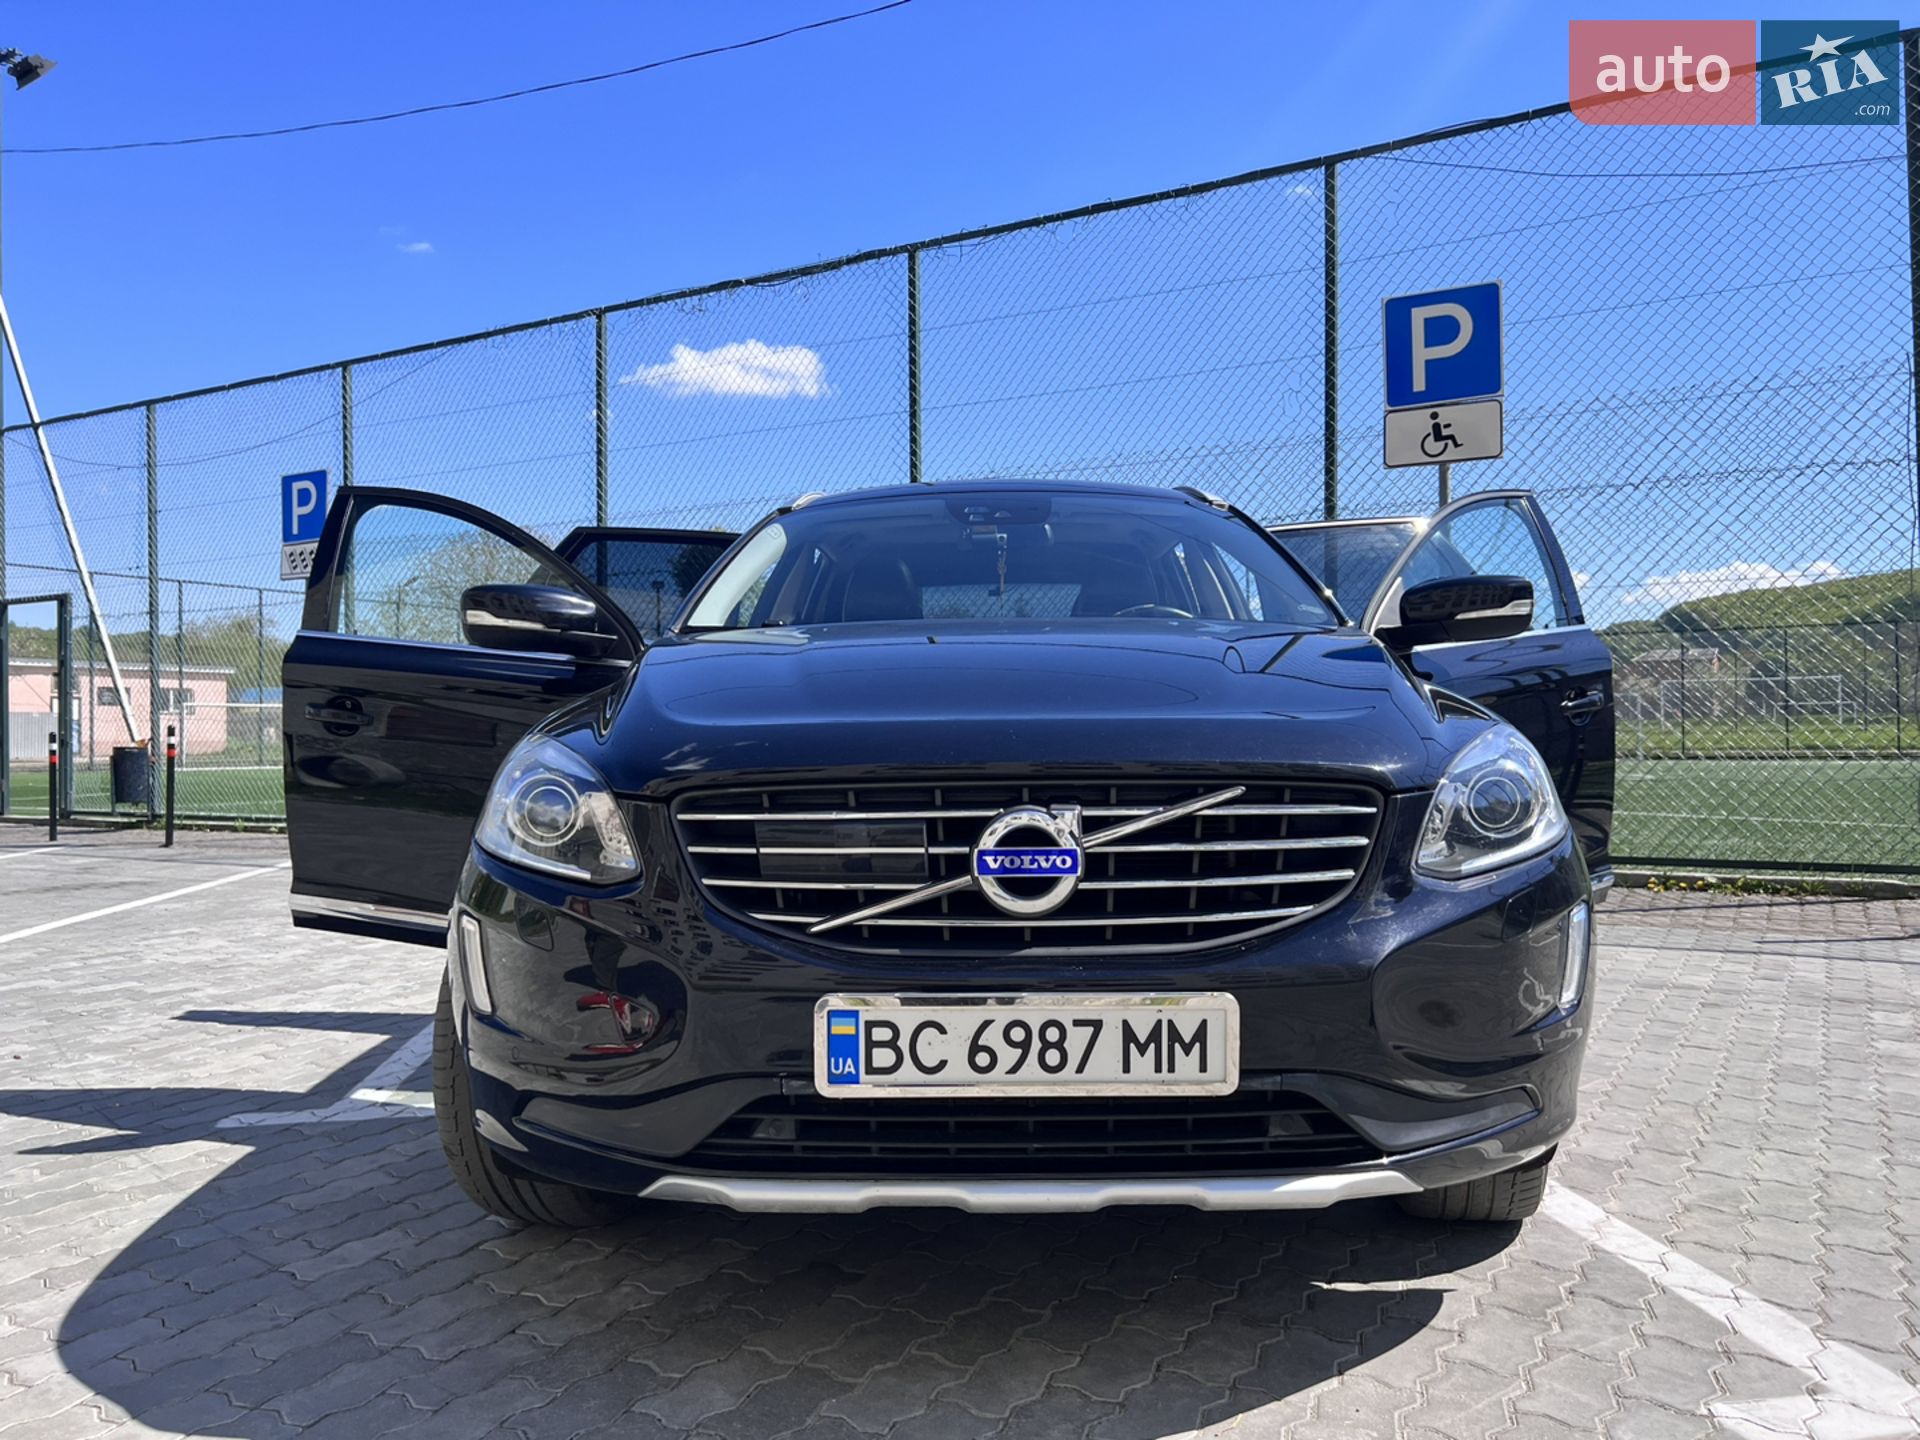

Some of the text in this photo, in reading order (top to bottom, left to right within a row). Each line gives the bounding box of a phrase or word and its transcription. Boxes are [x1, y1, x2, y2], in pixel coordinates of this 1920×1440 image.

[1411, 303, 1474, 392] P
[292, 480, 317, 536] P
[982, 855, 1073, 869] VOLVO
[831, 1057, 856, 1075] UA
[863, 1018, 1208, 1076] BC 6987 MM
